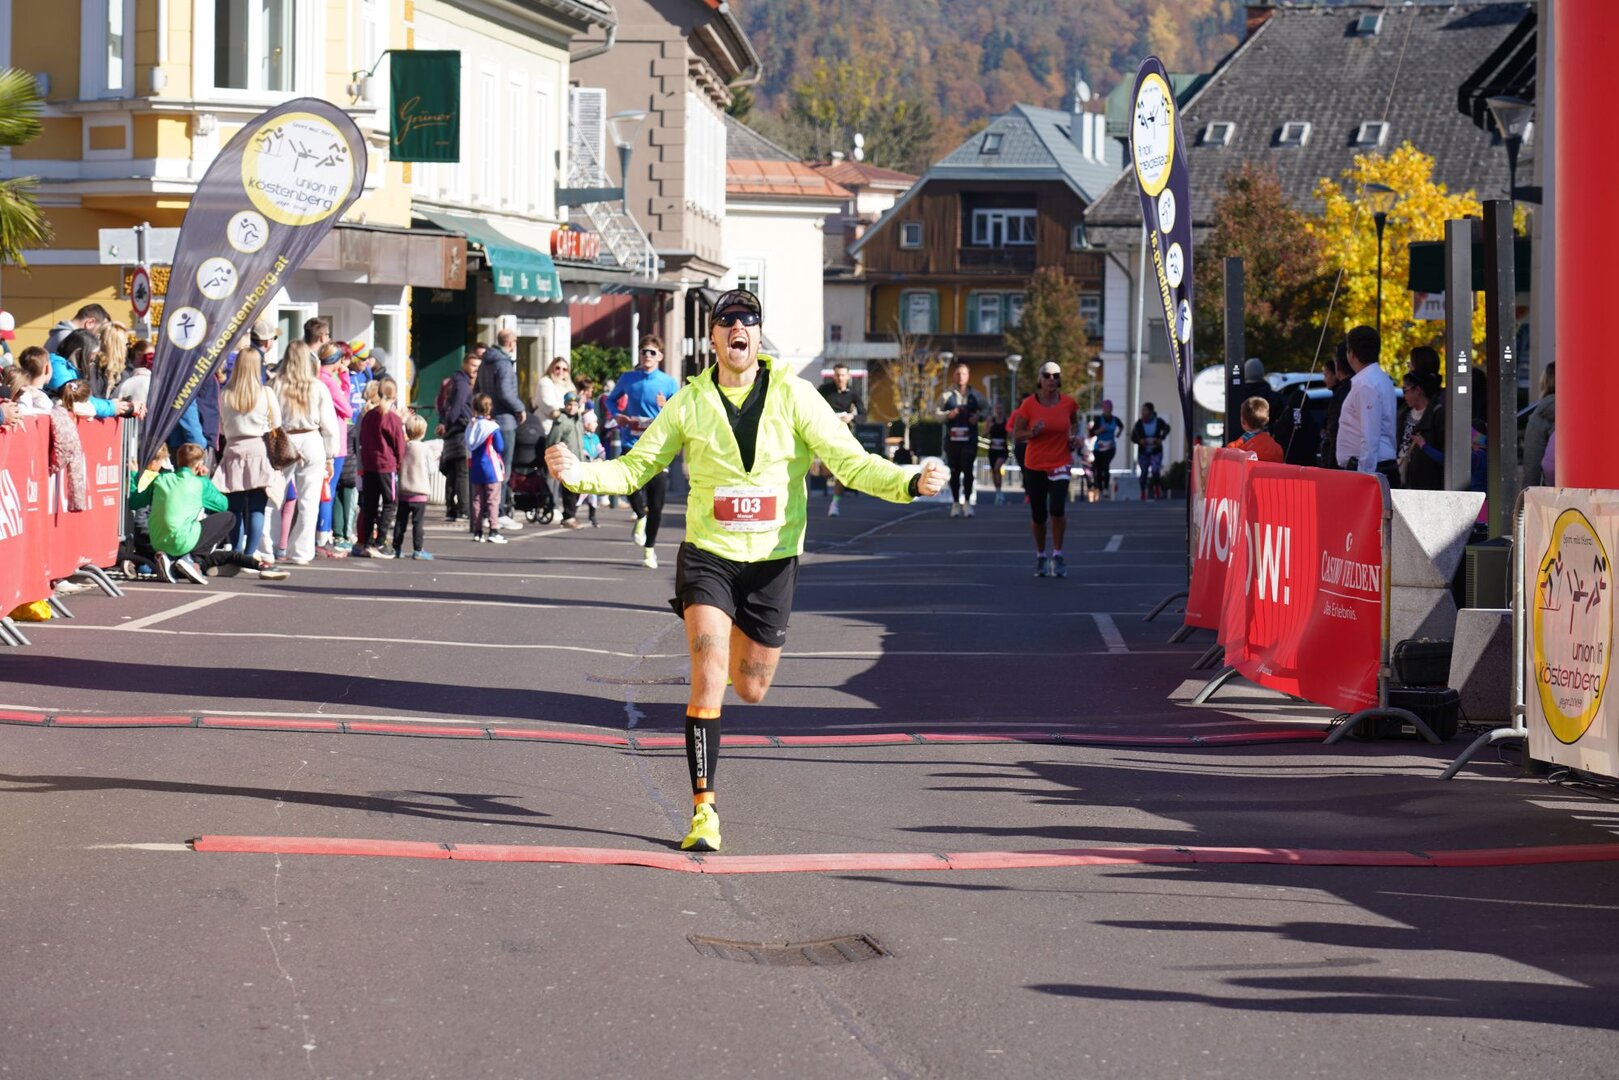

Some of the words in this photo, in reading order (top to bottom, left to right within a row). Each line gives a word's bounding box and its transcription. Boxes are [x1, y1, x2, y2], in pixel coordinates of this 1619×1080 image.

[296, 177, 326, 194] union
[731, 497, 761, 514] 103
[1331, 602, 1358, 620] Erlebnis.
[1572, 641, 1595, 664] union
[1539, 661, 1601, 699] köstenberg
